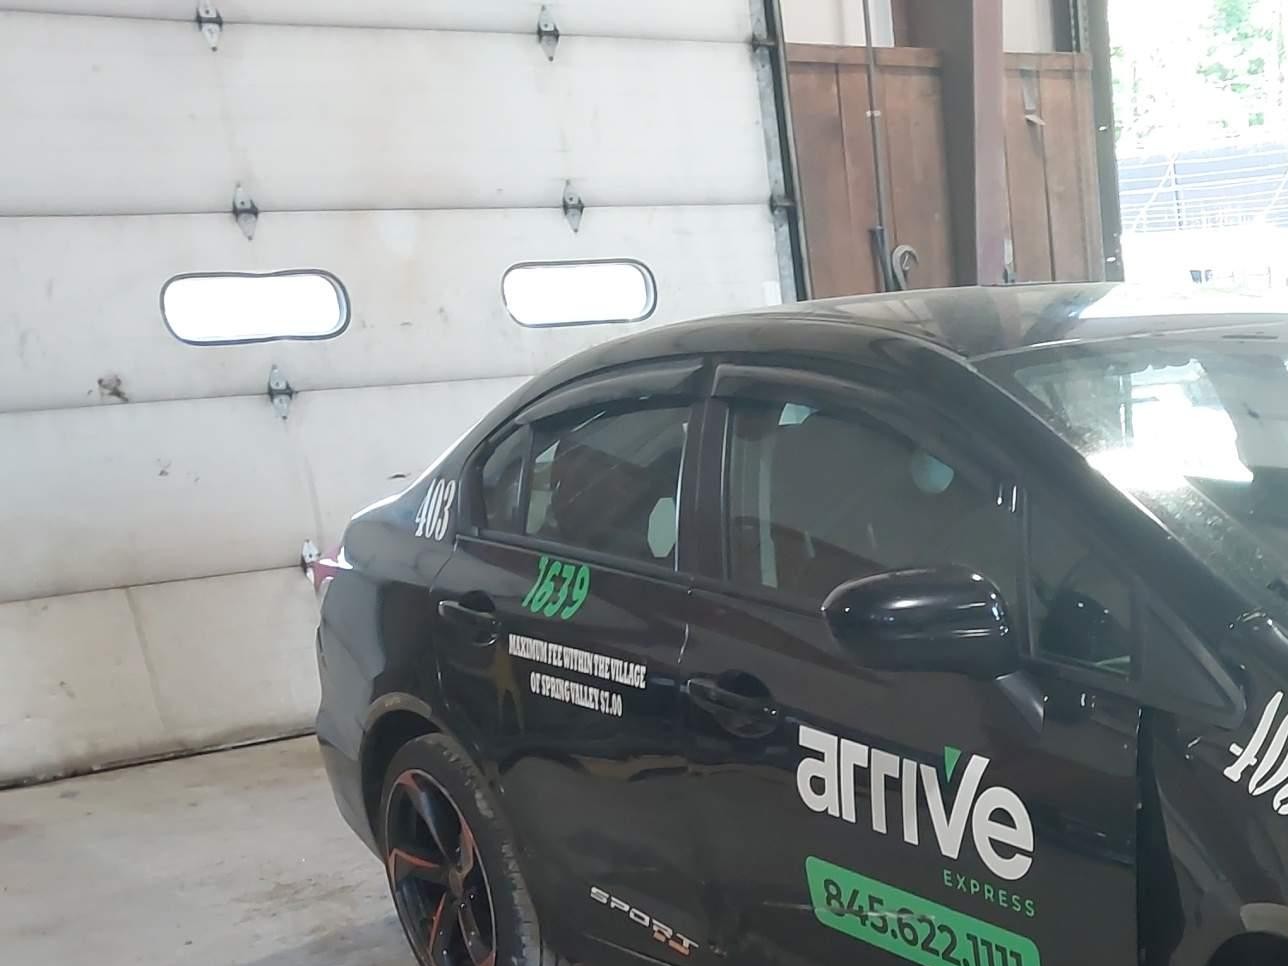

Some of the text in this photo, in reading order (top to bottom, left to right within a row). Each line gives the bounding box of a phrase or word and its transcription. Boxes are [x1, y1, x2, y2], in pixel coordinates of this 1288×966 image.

[415, 478, 456, 541] 403
[521, 553, 590, 620] 1639
[508, 633, 647, 689] MAXIMUM FEE WITHIN THE VILLAGE
[530, 671, 623, 717] OF SPRING VALLEY $7.00
[590, 886, 699, 953] SPORT
[943, 869, 1036, 917] EXPRESS
